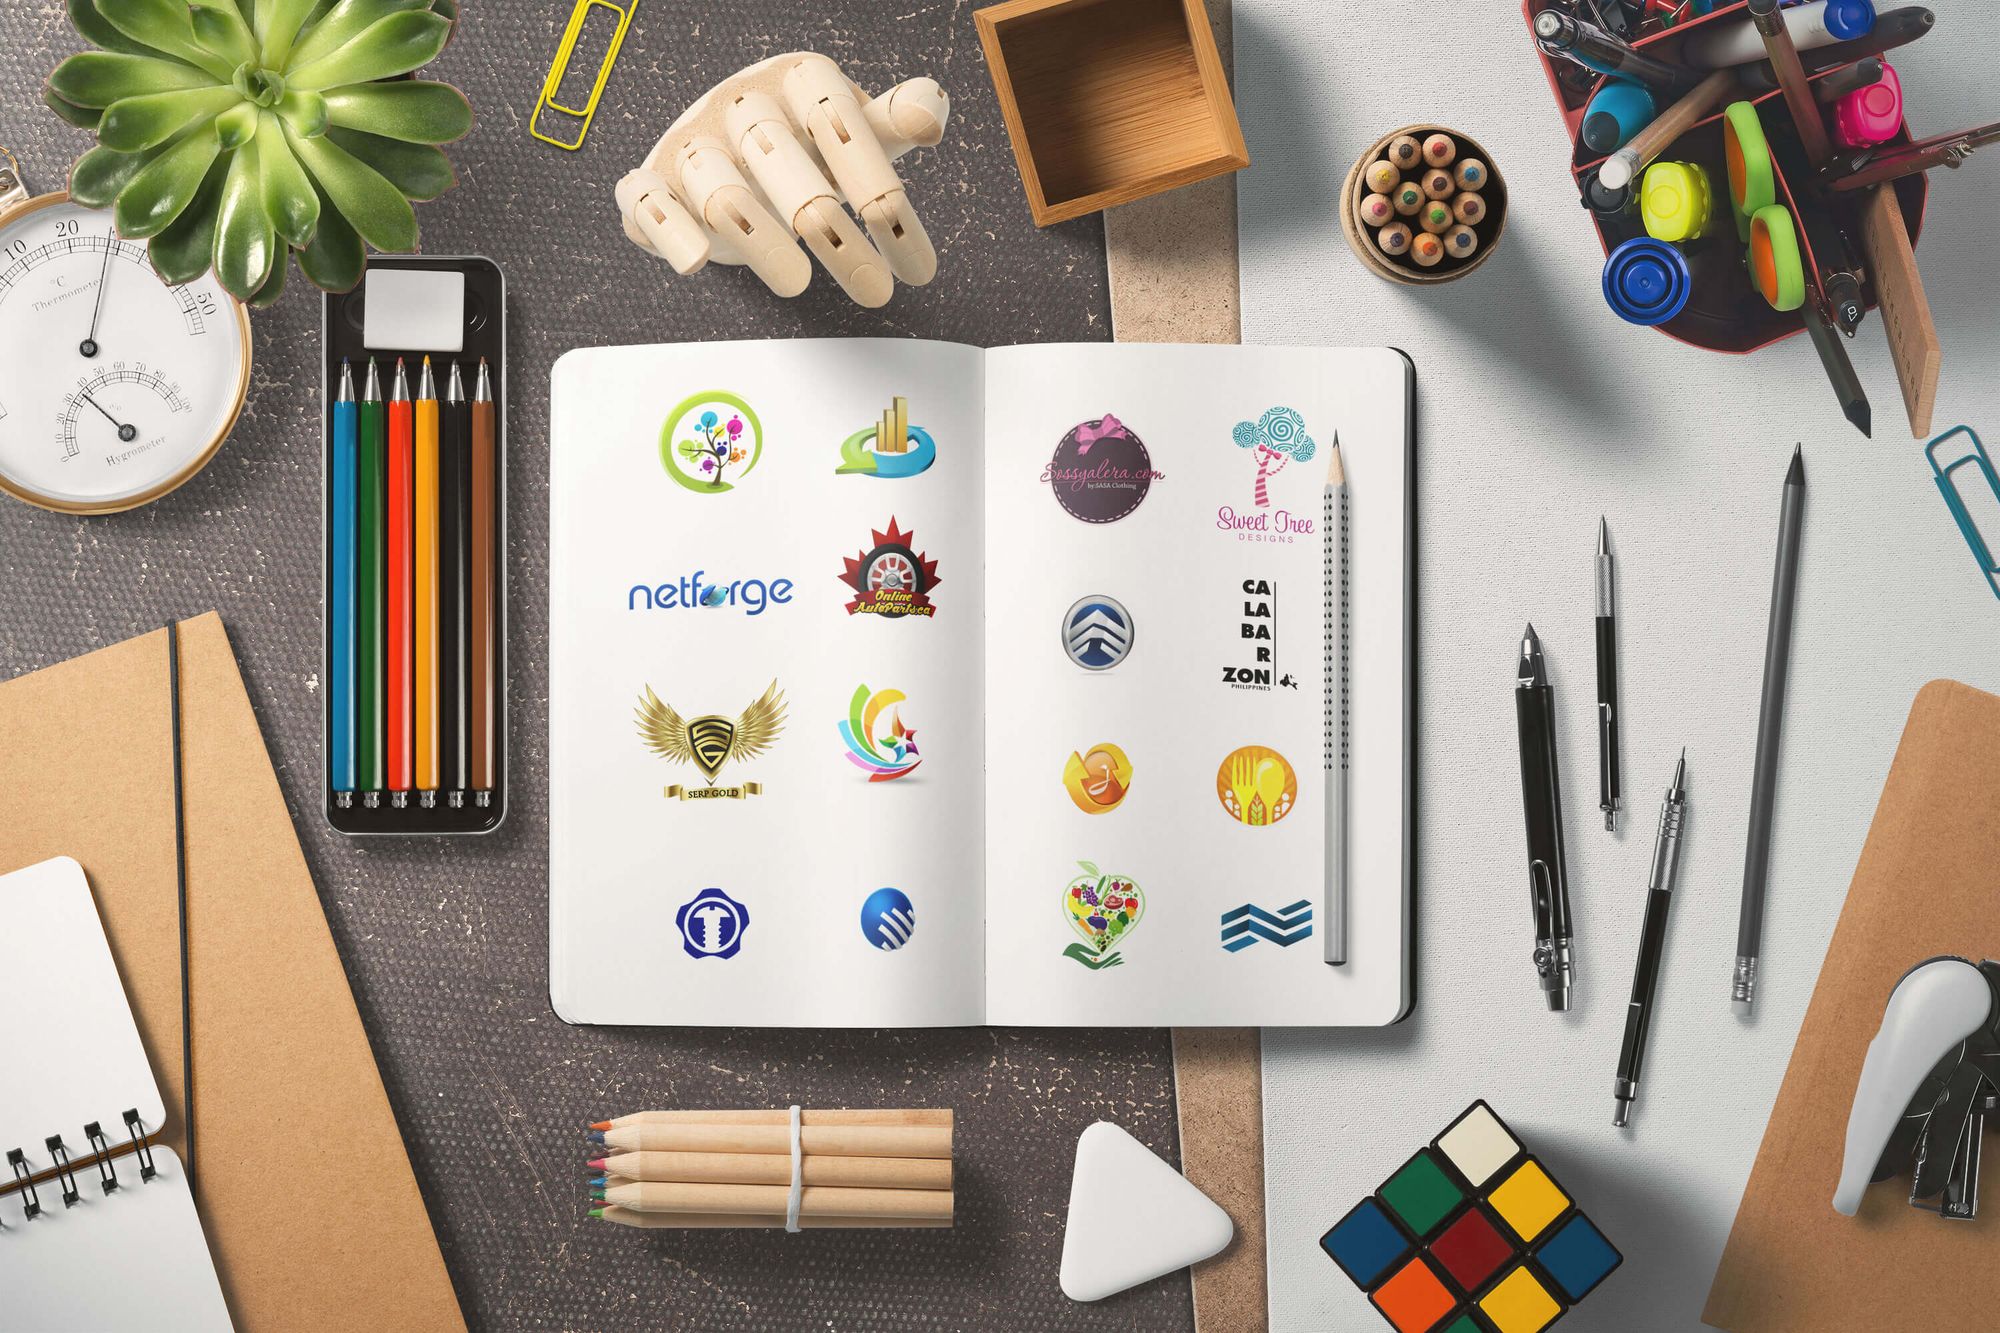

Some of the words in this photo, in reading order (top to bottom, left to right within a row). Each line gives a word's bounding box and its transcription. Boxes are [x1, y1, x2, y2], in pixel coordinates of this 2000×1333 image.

[56, 219, 79, 237] 20
[4, 239, 27, 261] 10
[197, 292, 217, 315] 50
[113, 361, 125, 370] 60
[135, 361, 147, 373] 70
[55, 412, 66, 425] 20
[55, 433, 66, 444] 10
[106, 436, 166, 467] Hygrometer
[1216, 505, 1269, 532] Sweet
[1274, 510, 1315, 534] Tree
[1238, 532, 1294, 544] DESIGNS
[629, 570, 793, 616] netforge
[875, 589, 913, 602] Online
[1242, 579, 1271, 596] CA
[1244, 601, 1271, 618] LA
[1241, 623, 1271, 640] BA
[1256, 646, 1271, 663] R
[1222, 666, 1270, 685] ZON
[1231, 683, 1271, 692] PHILIPPINES
[688, 790, 710, 799] SERP
[711, 789, 739, 798] GOLD
